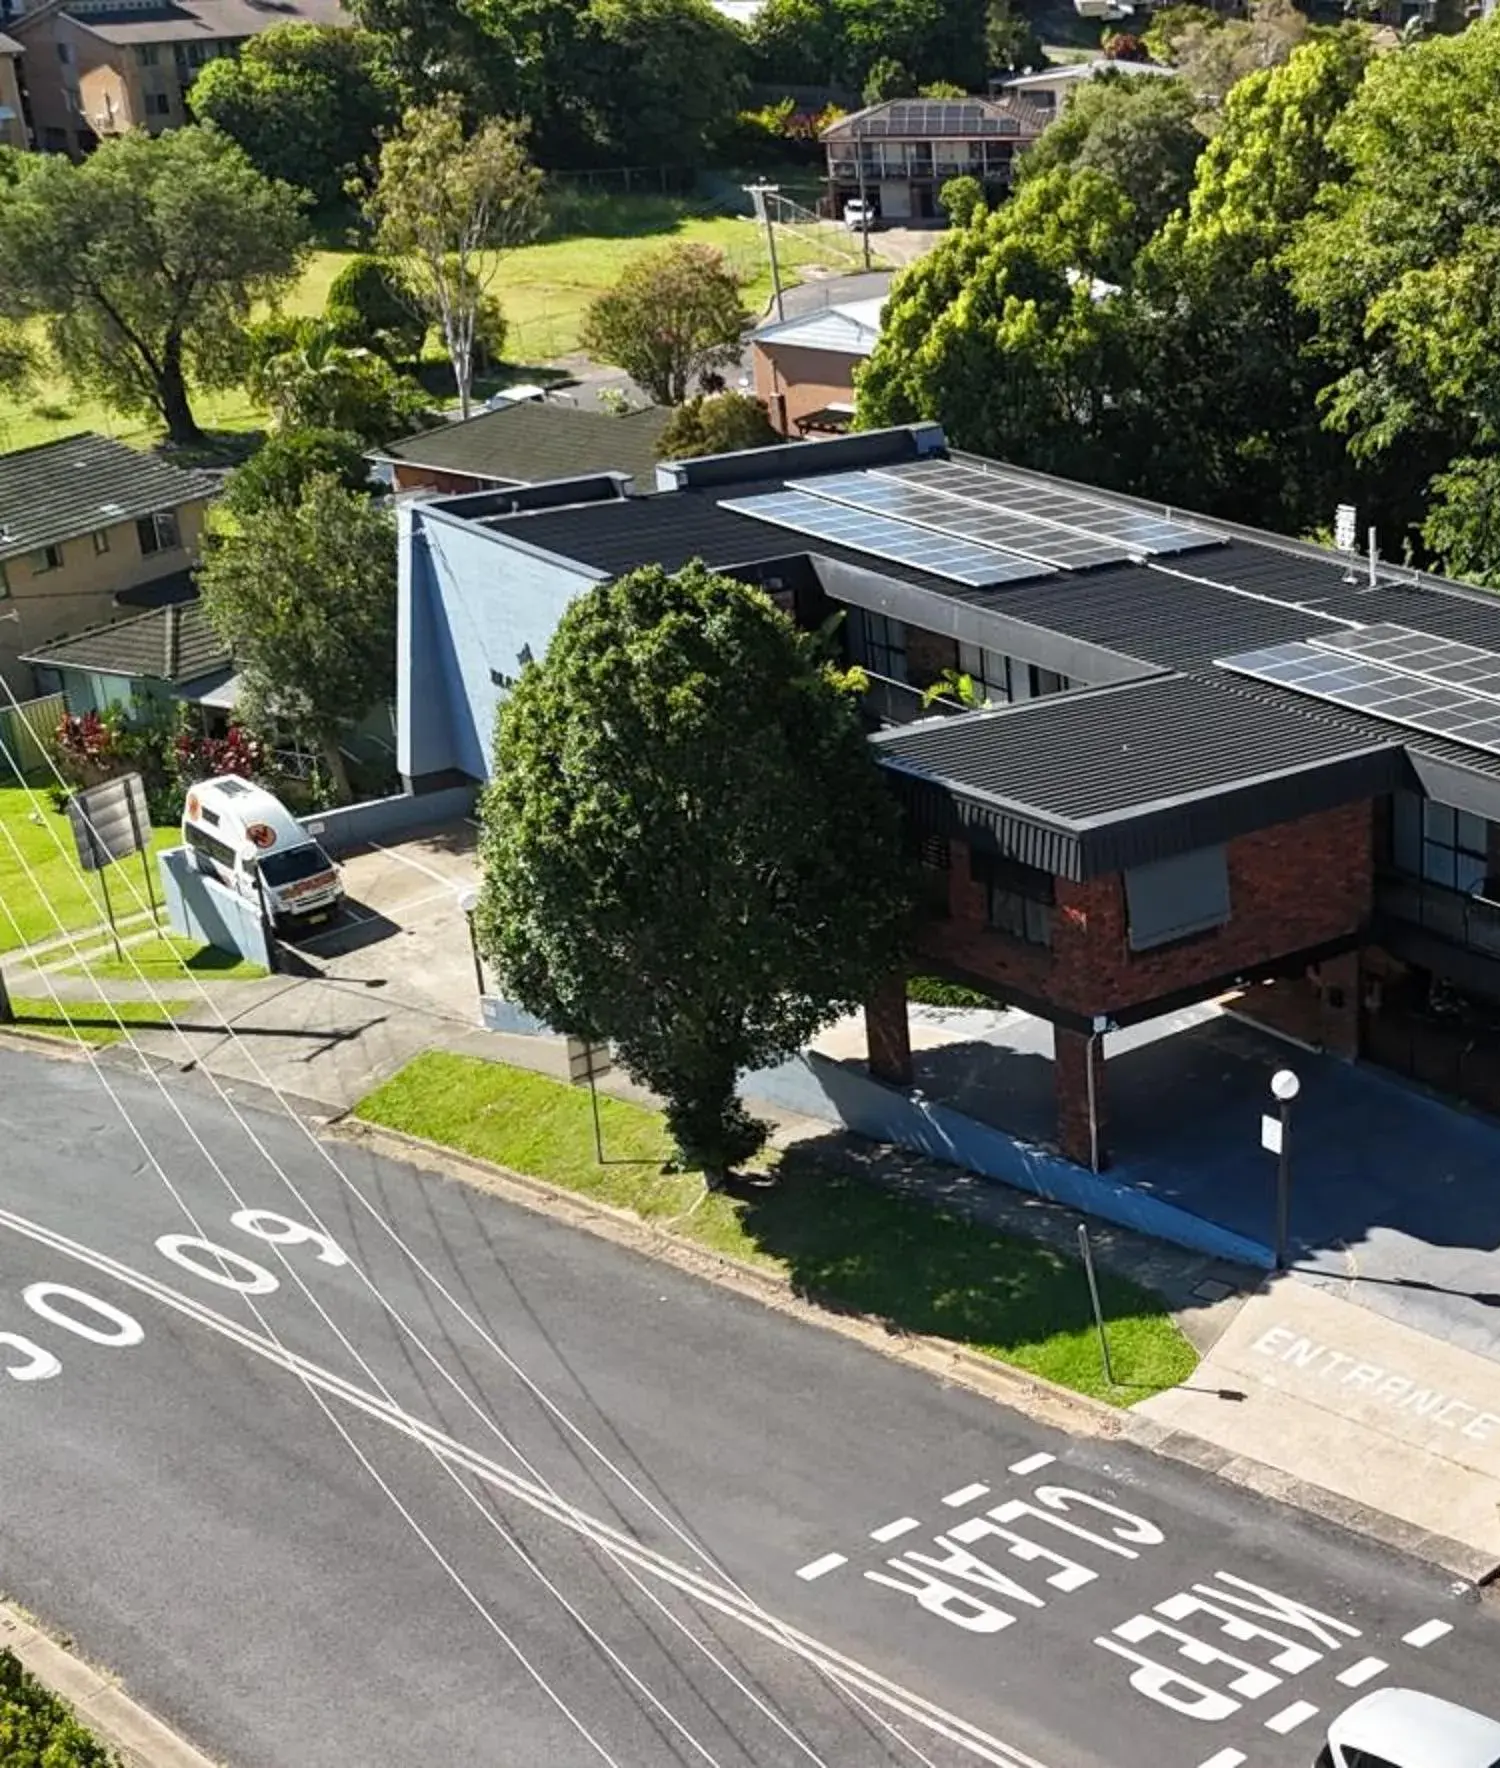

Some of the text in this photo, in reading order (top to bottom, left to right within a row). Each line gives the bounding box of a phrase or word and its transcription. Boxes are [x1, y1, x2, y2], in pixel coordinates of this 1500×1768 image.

[154, 1209, 348, 1295] 60
[864, 1484, 1166, 1633] CLEAR
[1093, 1570, 1362, 1722] KEEP
